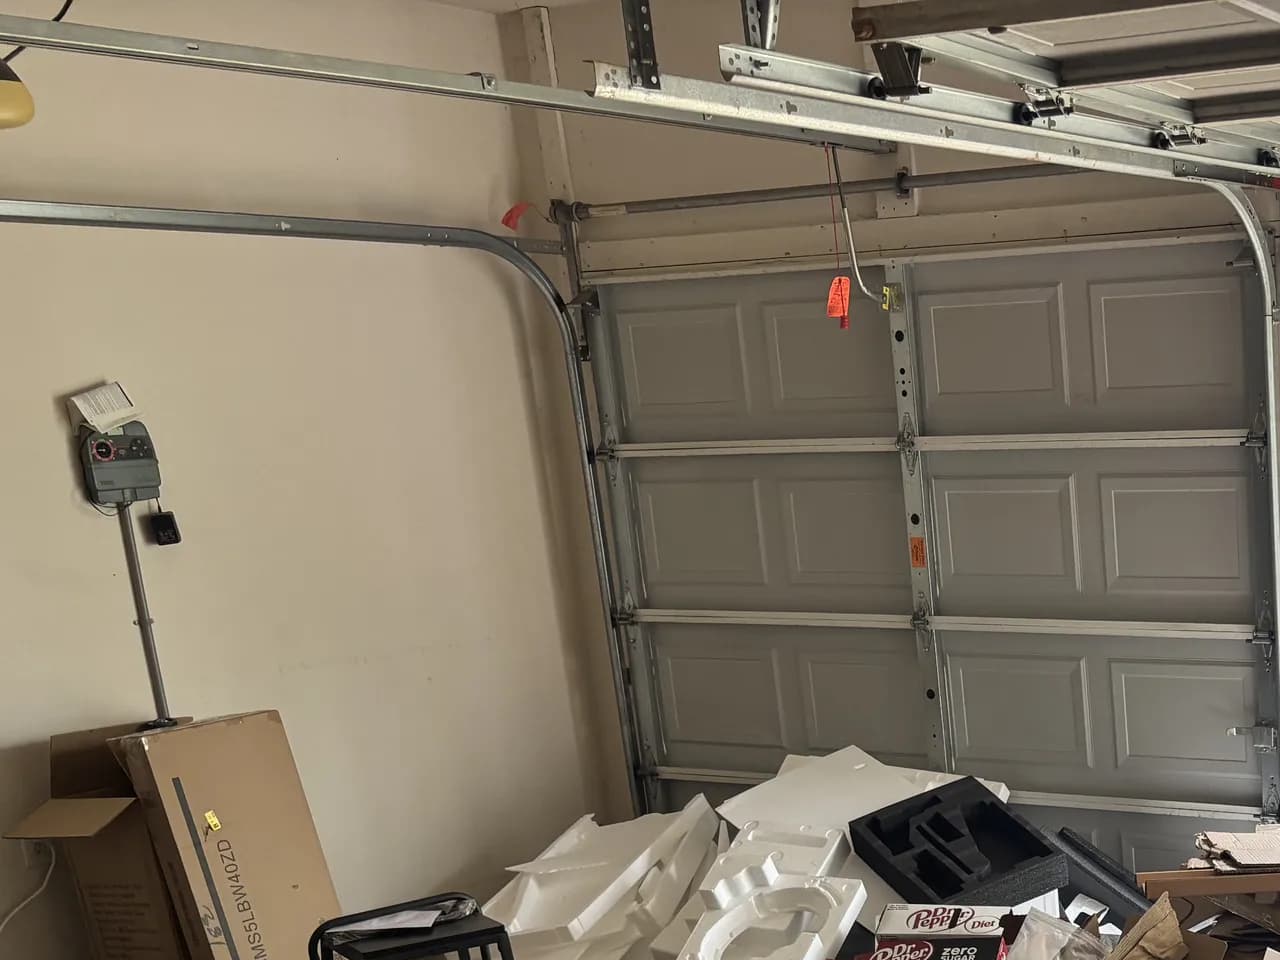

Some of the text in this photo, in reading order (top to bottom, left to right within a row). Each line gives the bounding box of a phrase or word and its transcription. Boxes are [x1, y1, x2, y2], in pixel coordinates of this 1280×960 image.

[912, 909, 995, 929] Peppr Diet
[892, 943, 978, 958] Dr zero
